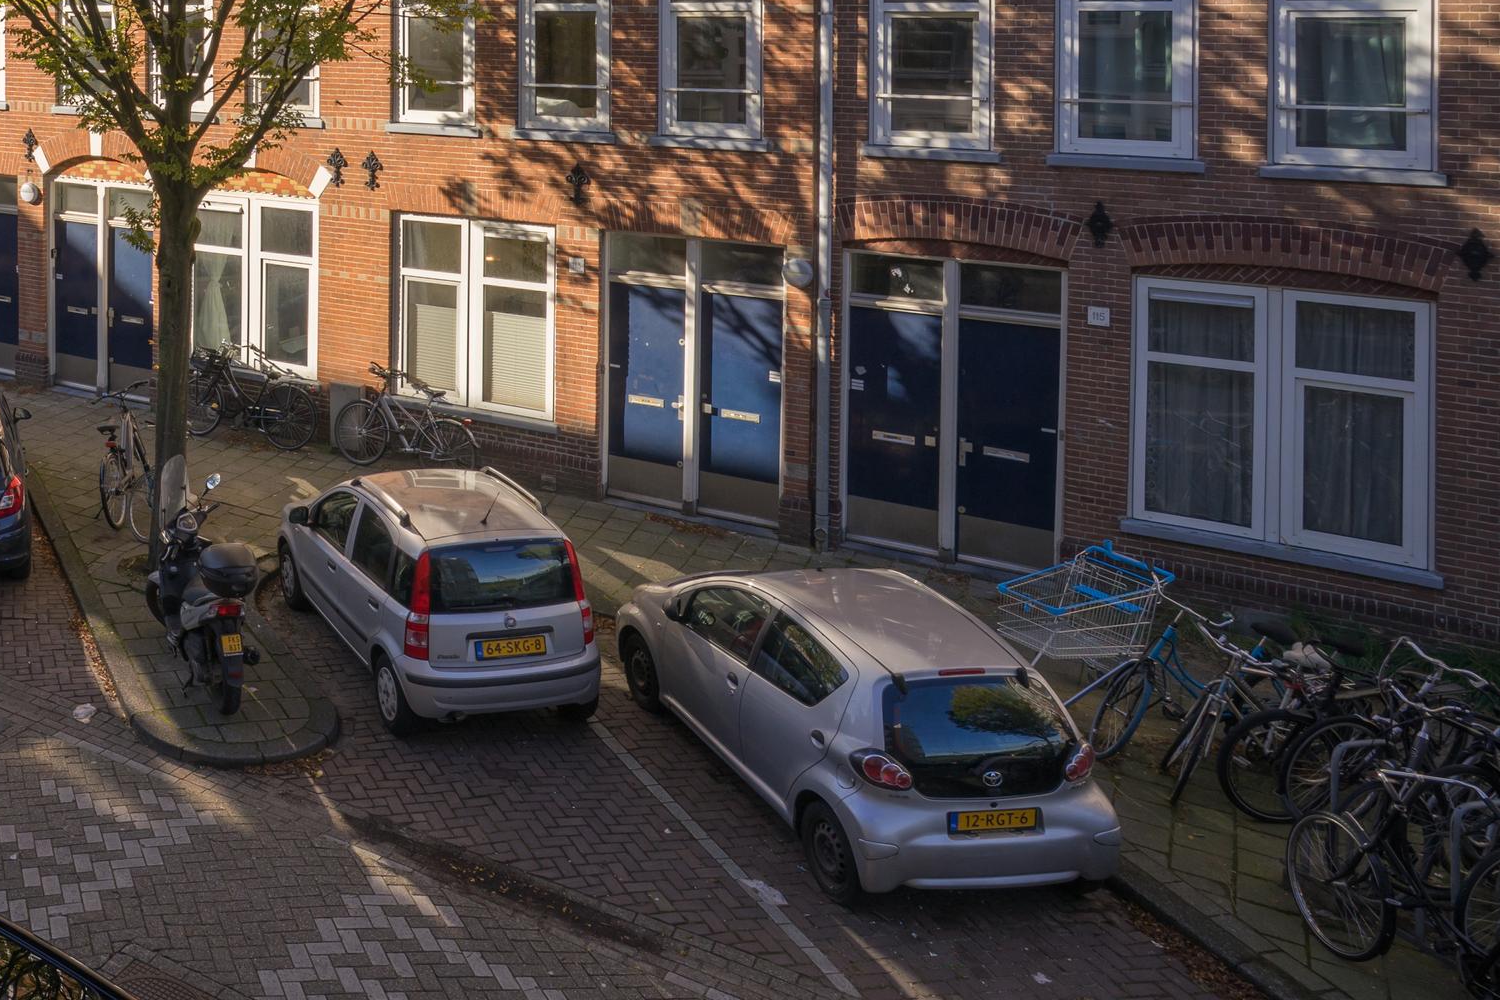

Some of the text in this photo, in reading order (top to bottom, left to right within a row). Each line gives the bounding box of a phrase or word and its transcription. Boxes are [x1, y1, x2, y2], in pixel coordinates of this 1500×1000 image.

[1092, 311, 1105, 321] 115
[486, 639, 542, 655] 64-SKG-8
[965, 812, 1028, 828] 12-RGT-6
